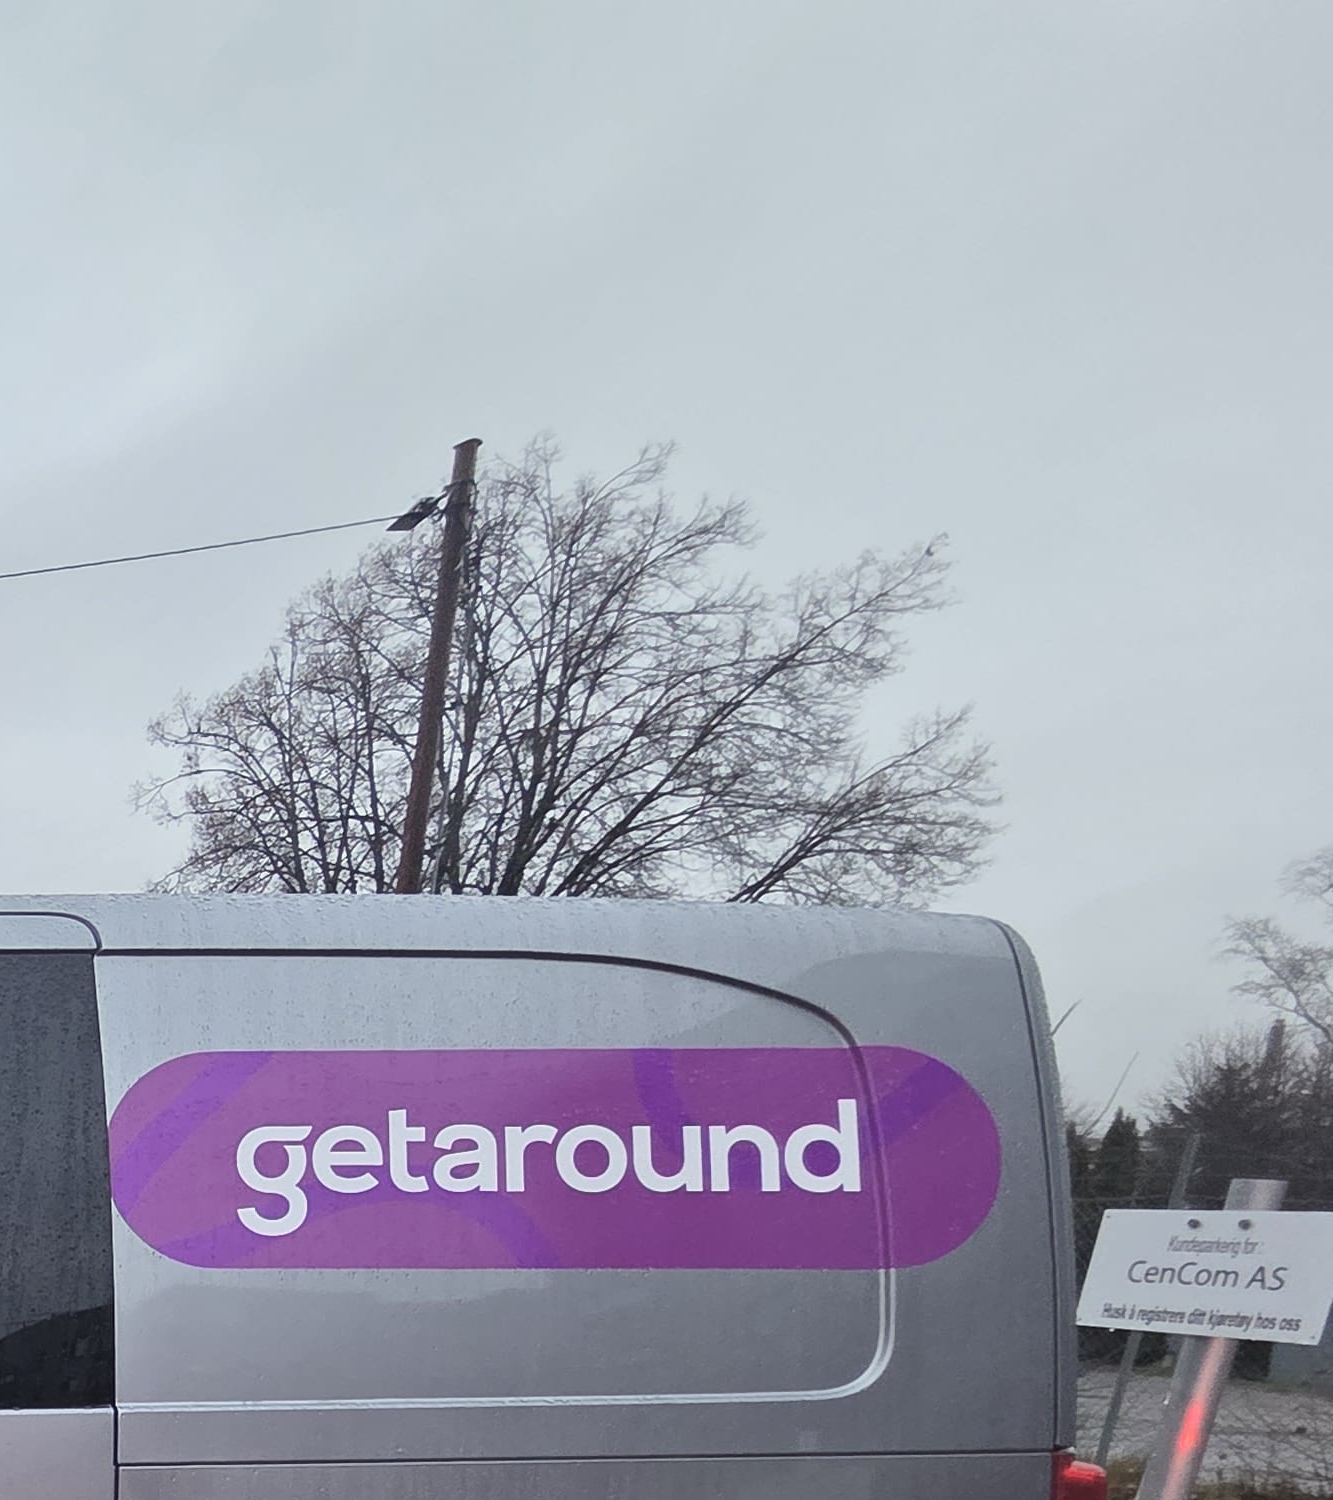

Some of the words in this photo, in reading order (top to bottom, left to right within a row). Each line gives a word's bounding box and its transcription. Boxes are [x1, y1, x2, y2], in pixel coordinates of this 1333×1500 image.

[235, 1098, 863, 1238] getaround
[1128, 1261, 1239, 1287] CenCom
[1245, 1266, 1288, 1291] AS
[1102, 1303, 1127, 1320] Husk
[1254, 1312, 1278, 1330] hos
[1279, 1318, 1301, 1332] oss
